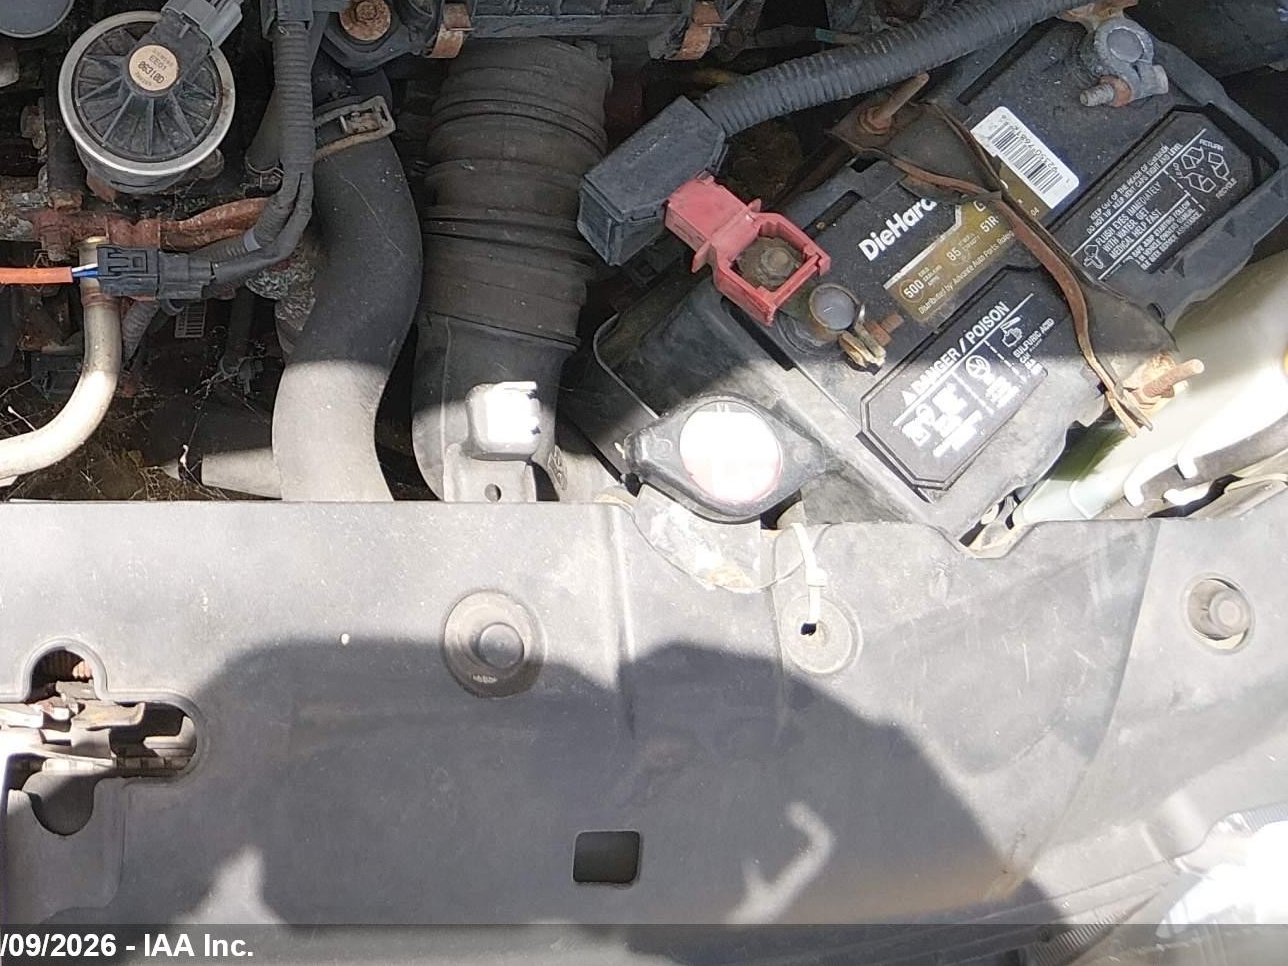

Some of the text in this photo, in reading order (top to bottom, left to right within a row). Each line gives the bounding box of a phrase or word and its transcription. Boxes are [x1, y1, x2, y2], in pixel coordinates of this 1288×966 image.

[1095, 180, 1162, 246] FLUSH EYES IMMEDIATELY
[1102, 236, 1119, 252] WITH
[1135, 207, 1149, 221] GET
[997, 229, 1014, 246] Raleig
[1109, 234, 1134, 259] MEDICAL
[1131, 220, 1148, 238] HELP
[902, 277, 924, 299] 500
[910, 345, 961, 395] DANGER
[965, 301, 1009, 344] POISON
[1012, 329, 1041, 358] SULFURIC
[1038, 316, 1055, 333] ACID
